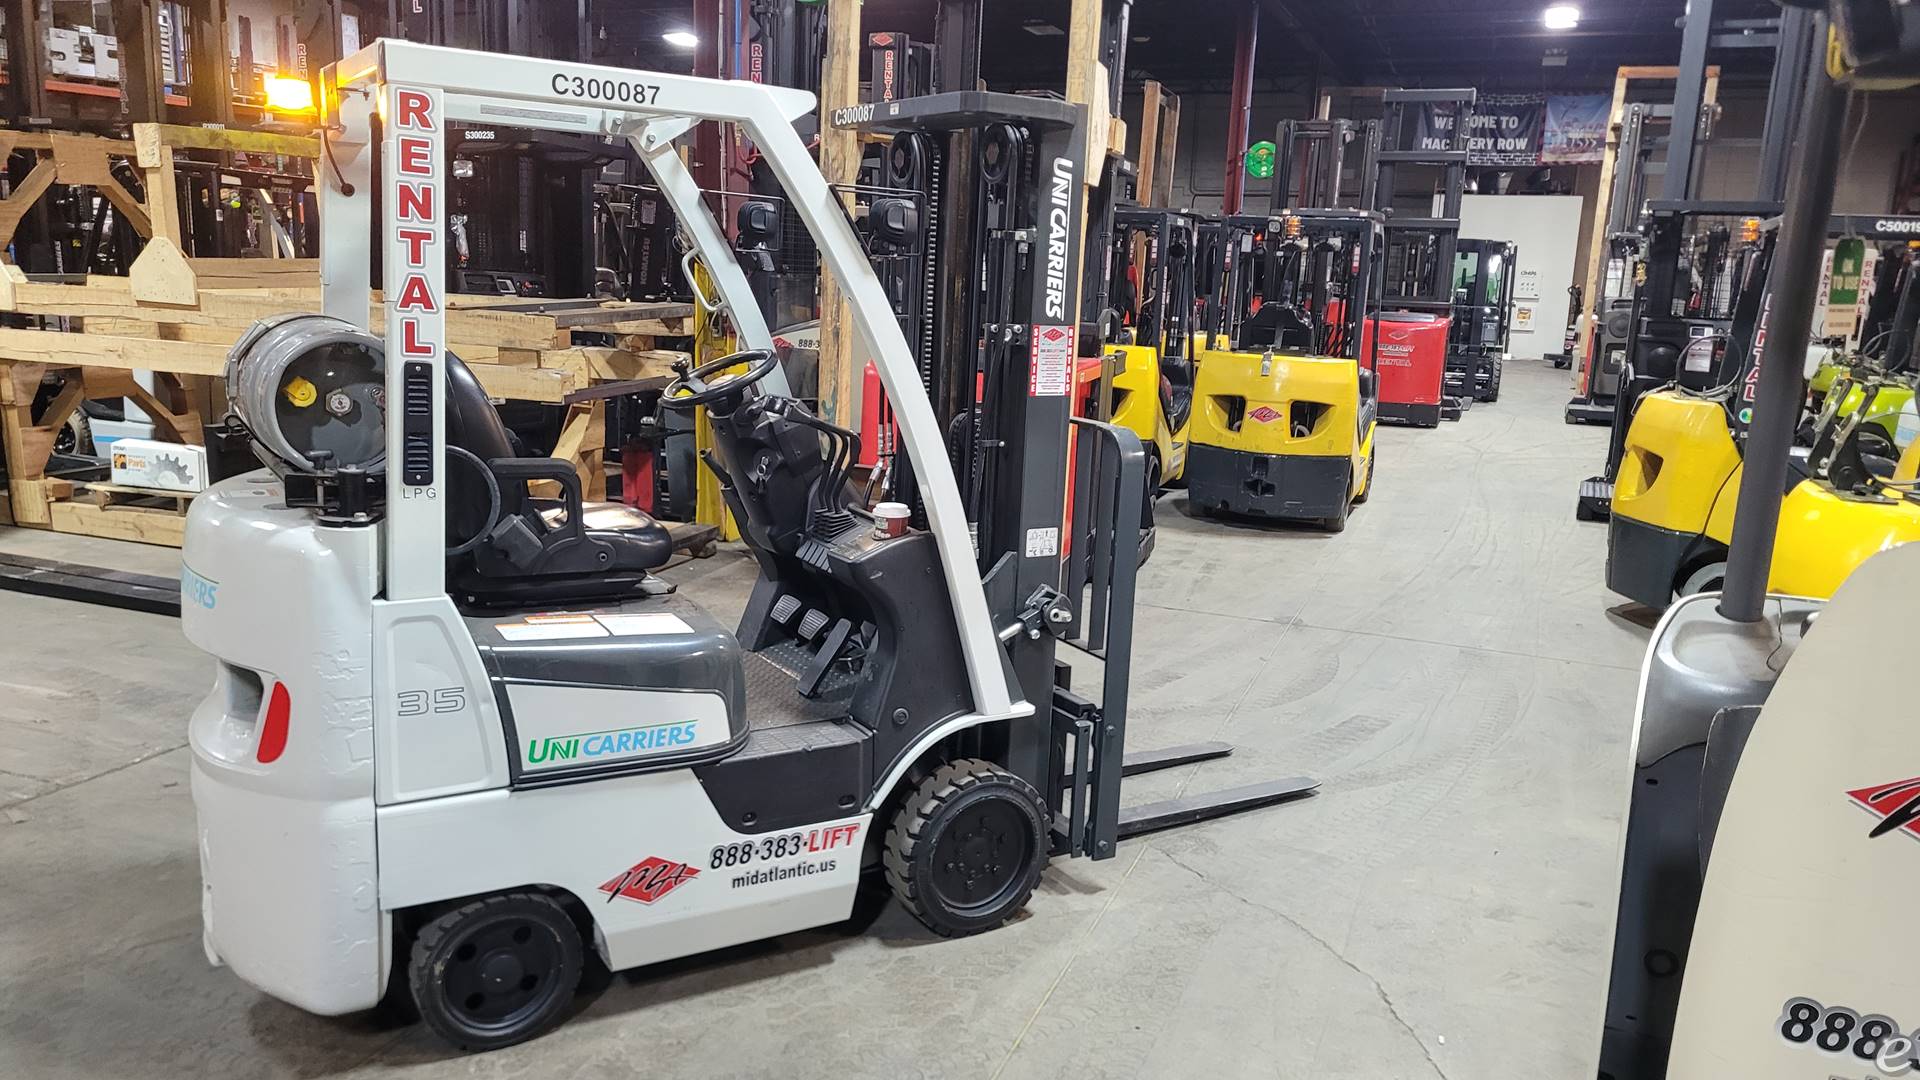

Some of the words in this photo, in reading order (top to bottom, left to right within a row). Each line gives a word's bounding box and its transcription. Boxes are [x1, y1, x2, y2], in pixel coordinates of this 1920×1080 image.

[551, 73, 660, 105] C300087
[835, 104, 875, 126] C300087
[1434, 116, 1496, 129] WEOME
[1501, 116, 1518, 129] TO
[464, 130, 495, 140] S300235
[1422, 137, 1494, 150] MACERY
[1497, 138, 1528, 150] ROW
[397, 89, 437, 356] RENTAL
[1856, 261, 1873, 315] RENTAL
[1030, 327, 1039, 392] SERVICE
[1065, 327, 1074, 392] RENTALS
[403, 487, 437, 500] LPG
[398, 687, 467, 717] 35
[732, 858, 836, 889] midatlantic.us
